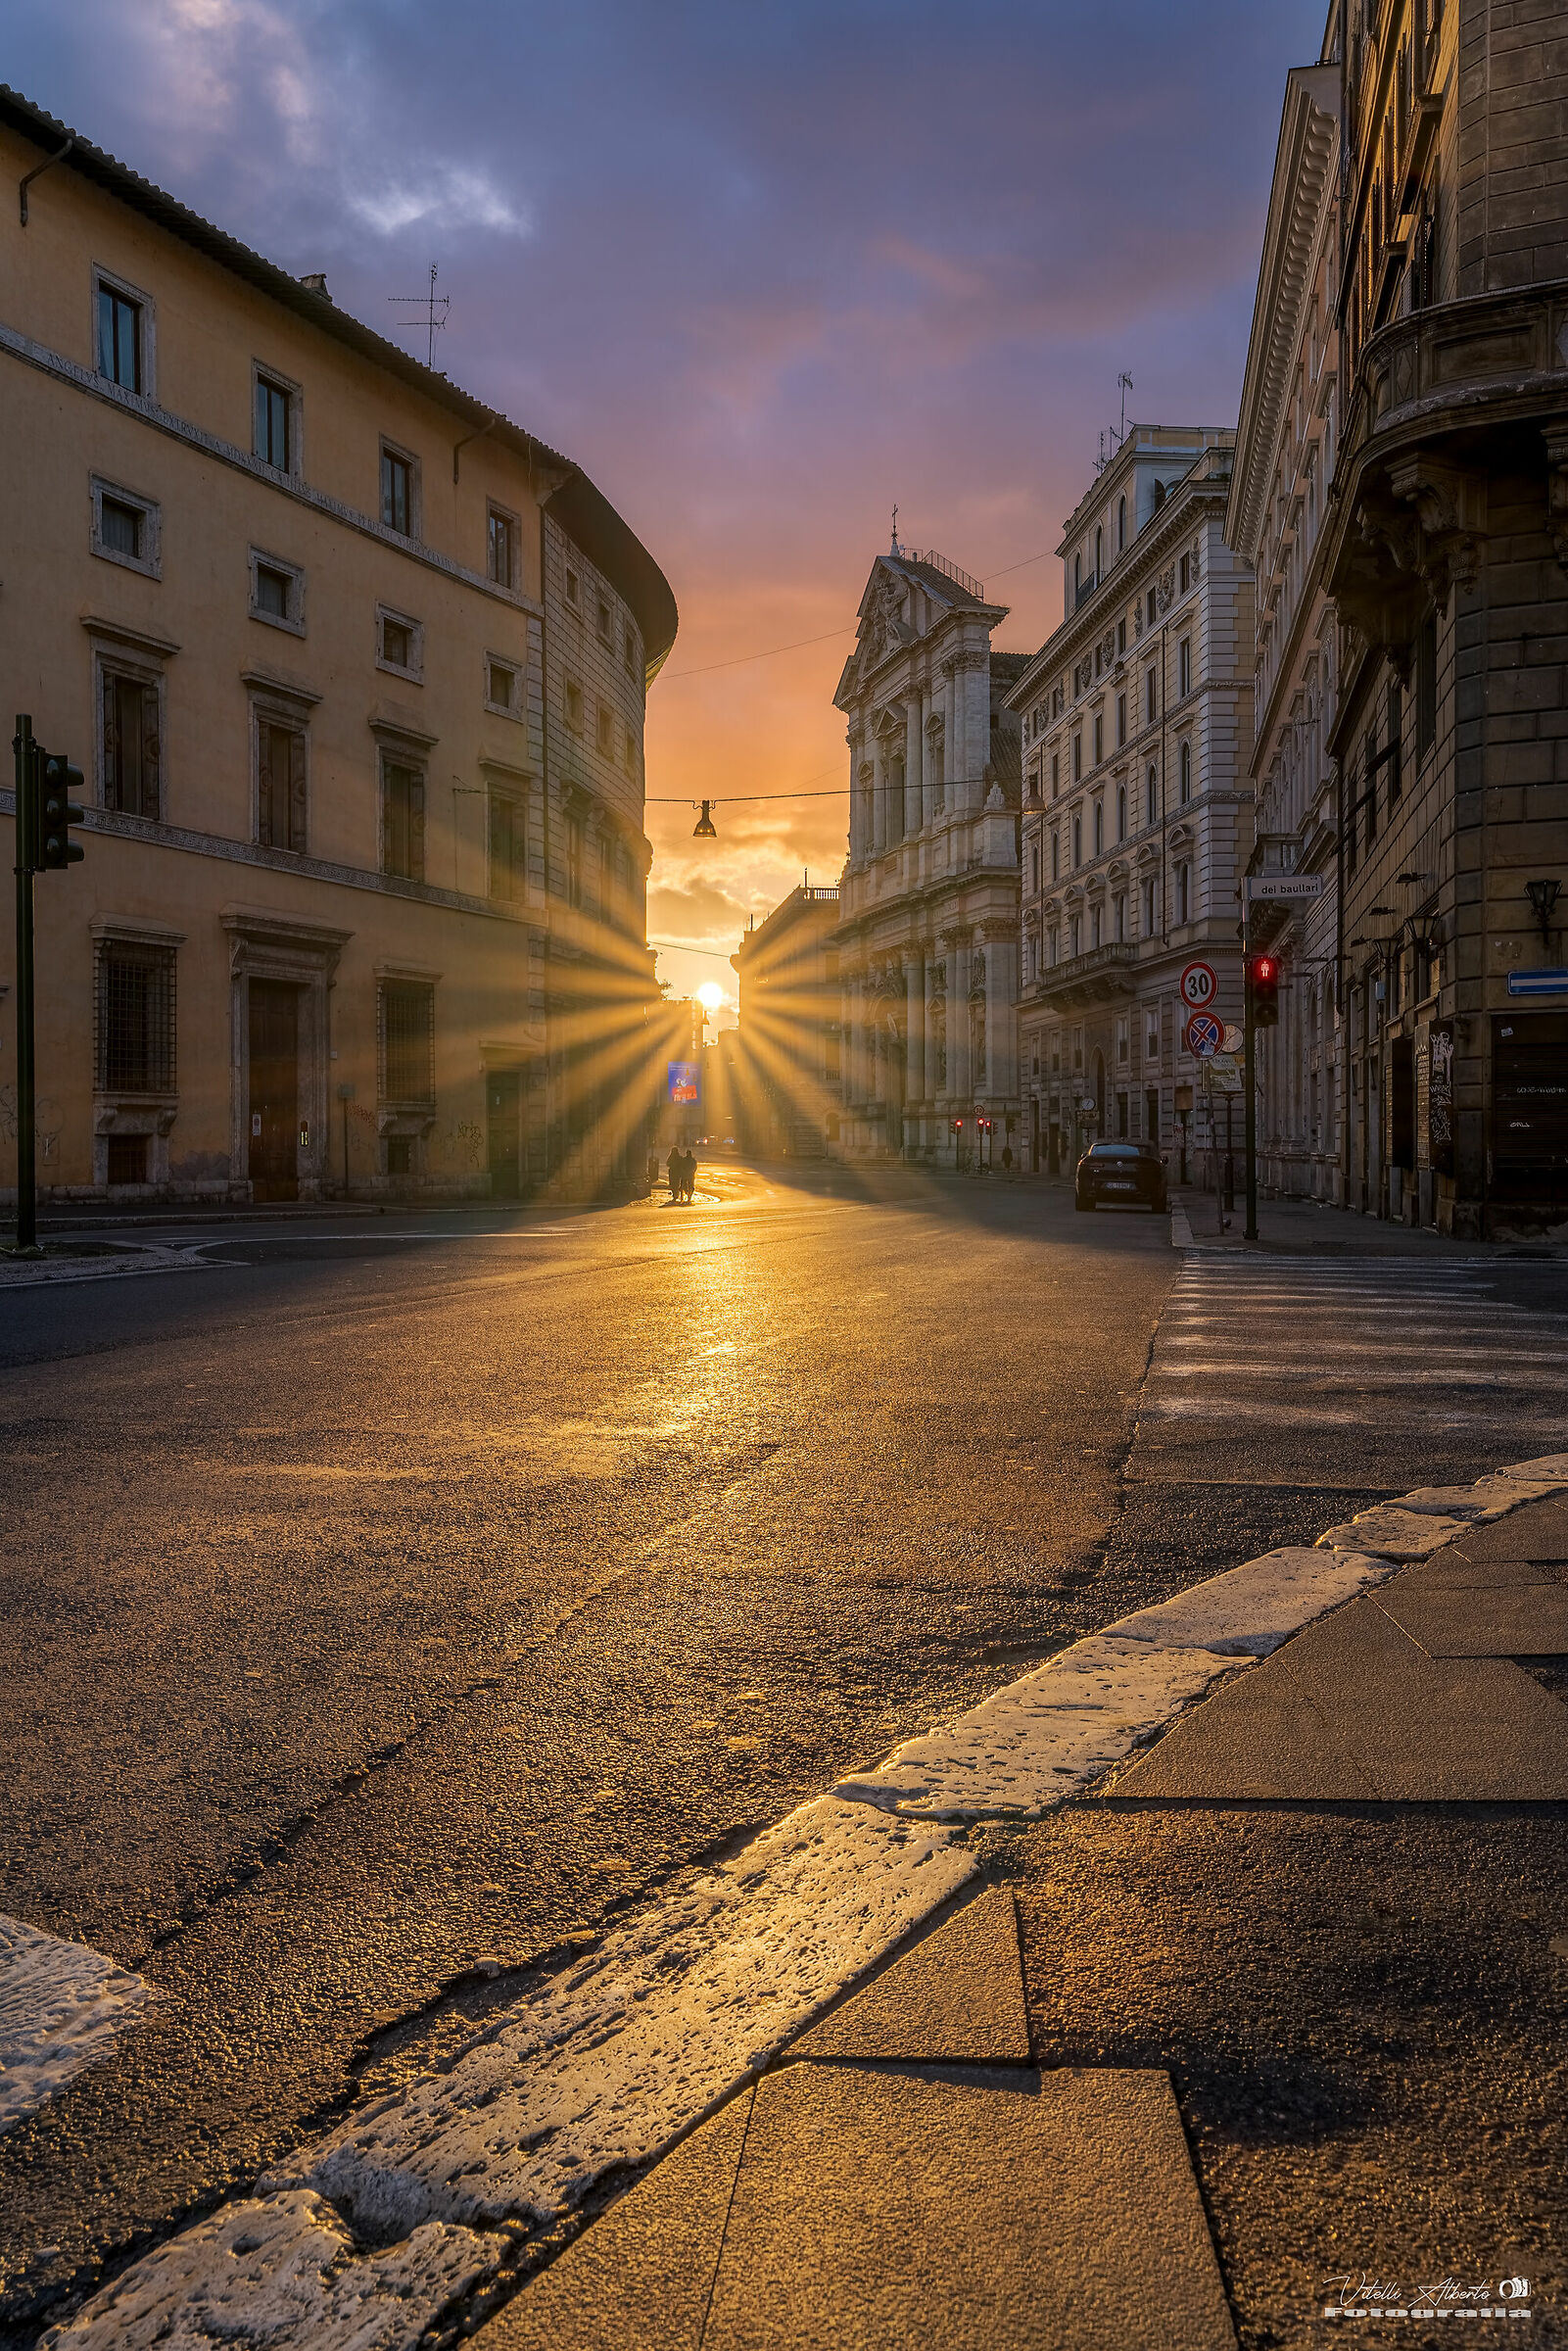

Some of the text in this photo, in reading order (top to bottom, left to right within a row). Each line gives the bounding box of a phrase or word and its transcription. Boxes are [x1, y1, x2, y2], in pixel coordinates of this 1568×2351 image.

[1261, 883, 1318, 894] dei baullari
[1188, 974, 1210, 998] 30
